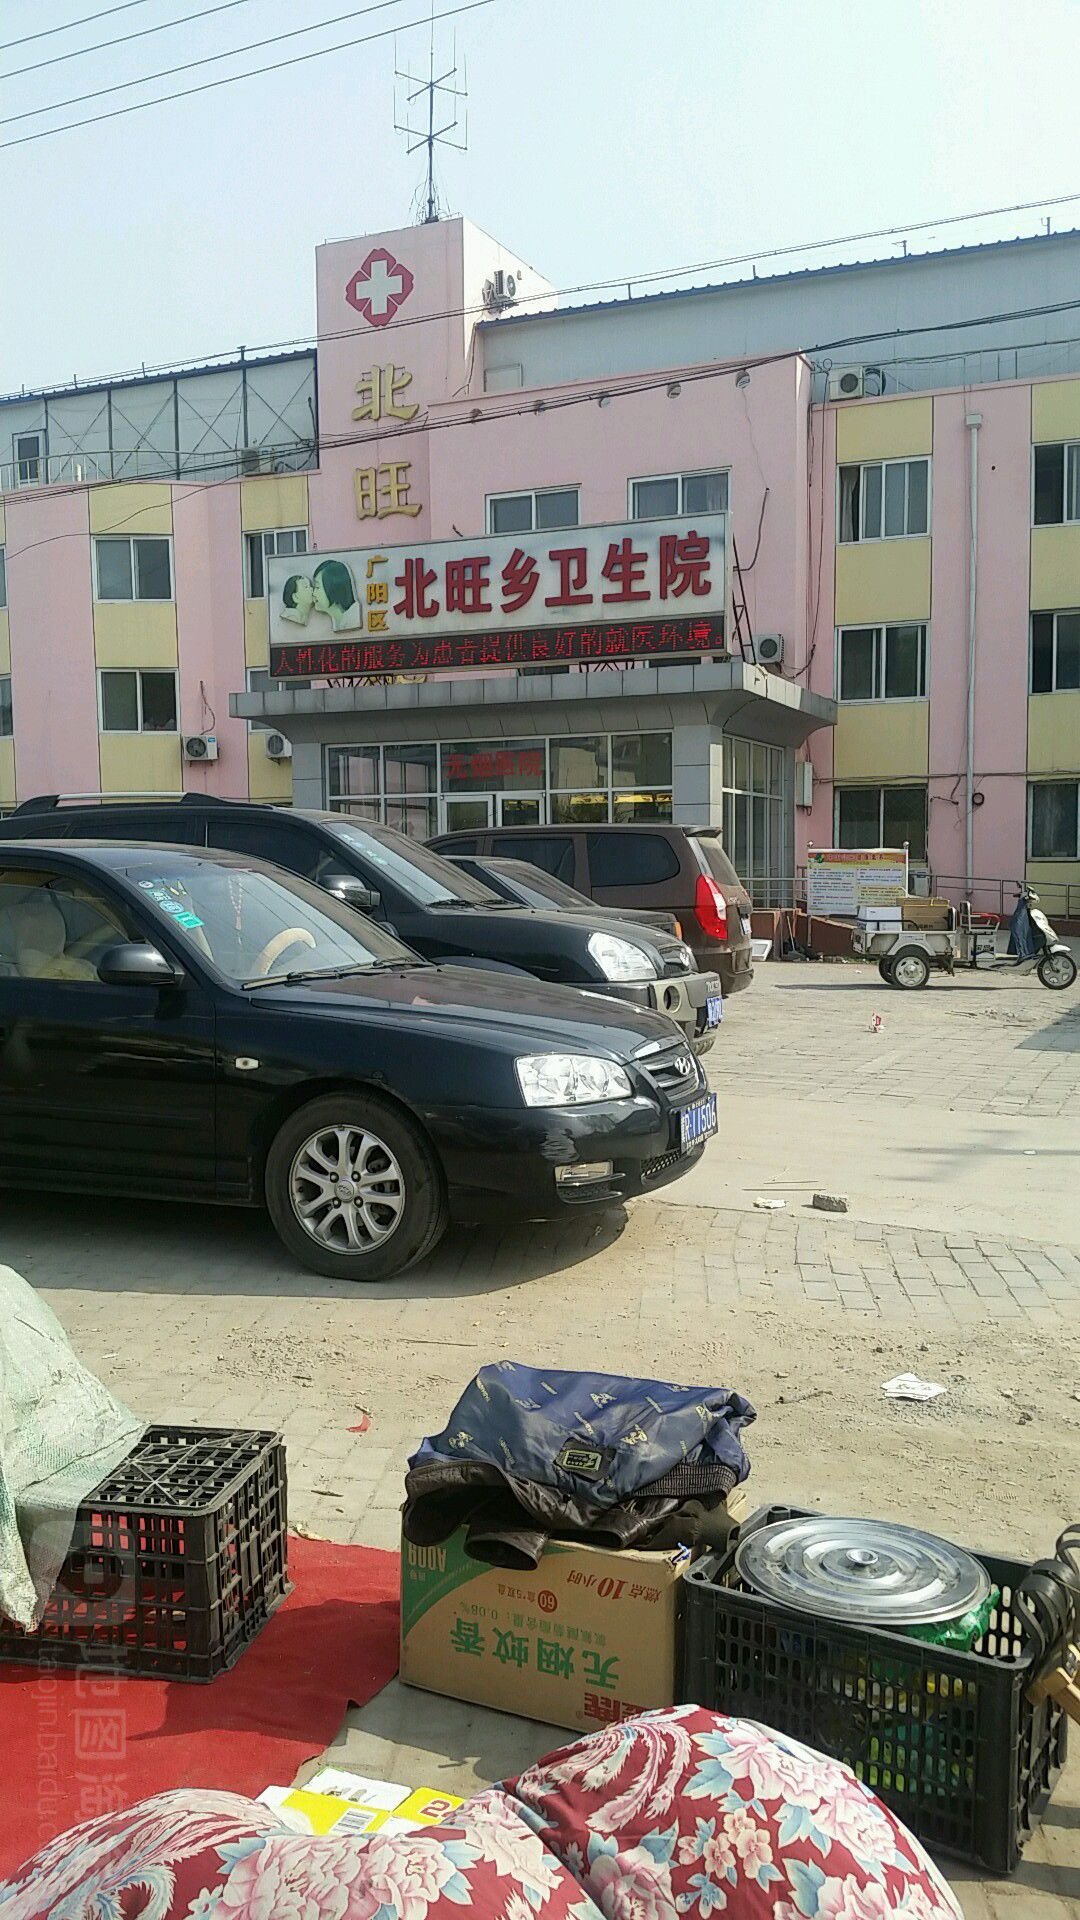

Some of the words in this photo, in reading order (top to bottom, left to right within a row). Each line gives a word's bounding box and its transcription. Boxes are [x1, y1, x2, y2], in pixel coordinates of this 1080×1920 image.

[366, 554, 389, 632] 广阳区
[393, 530, 712, 620] 北旺乡卫生院
[450, 1617, 621, 1690] 无烟蚊香
